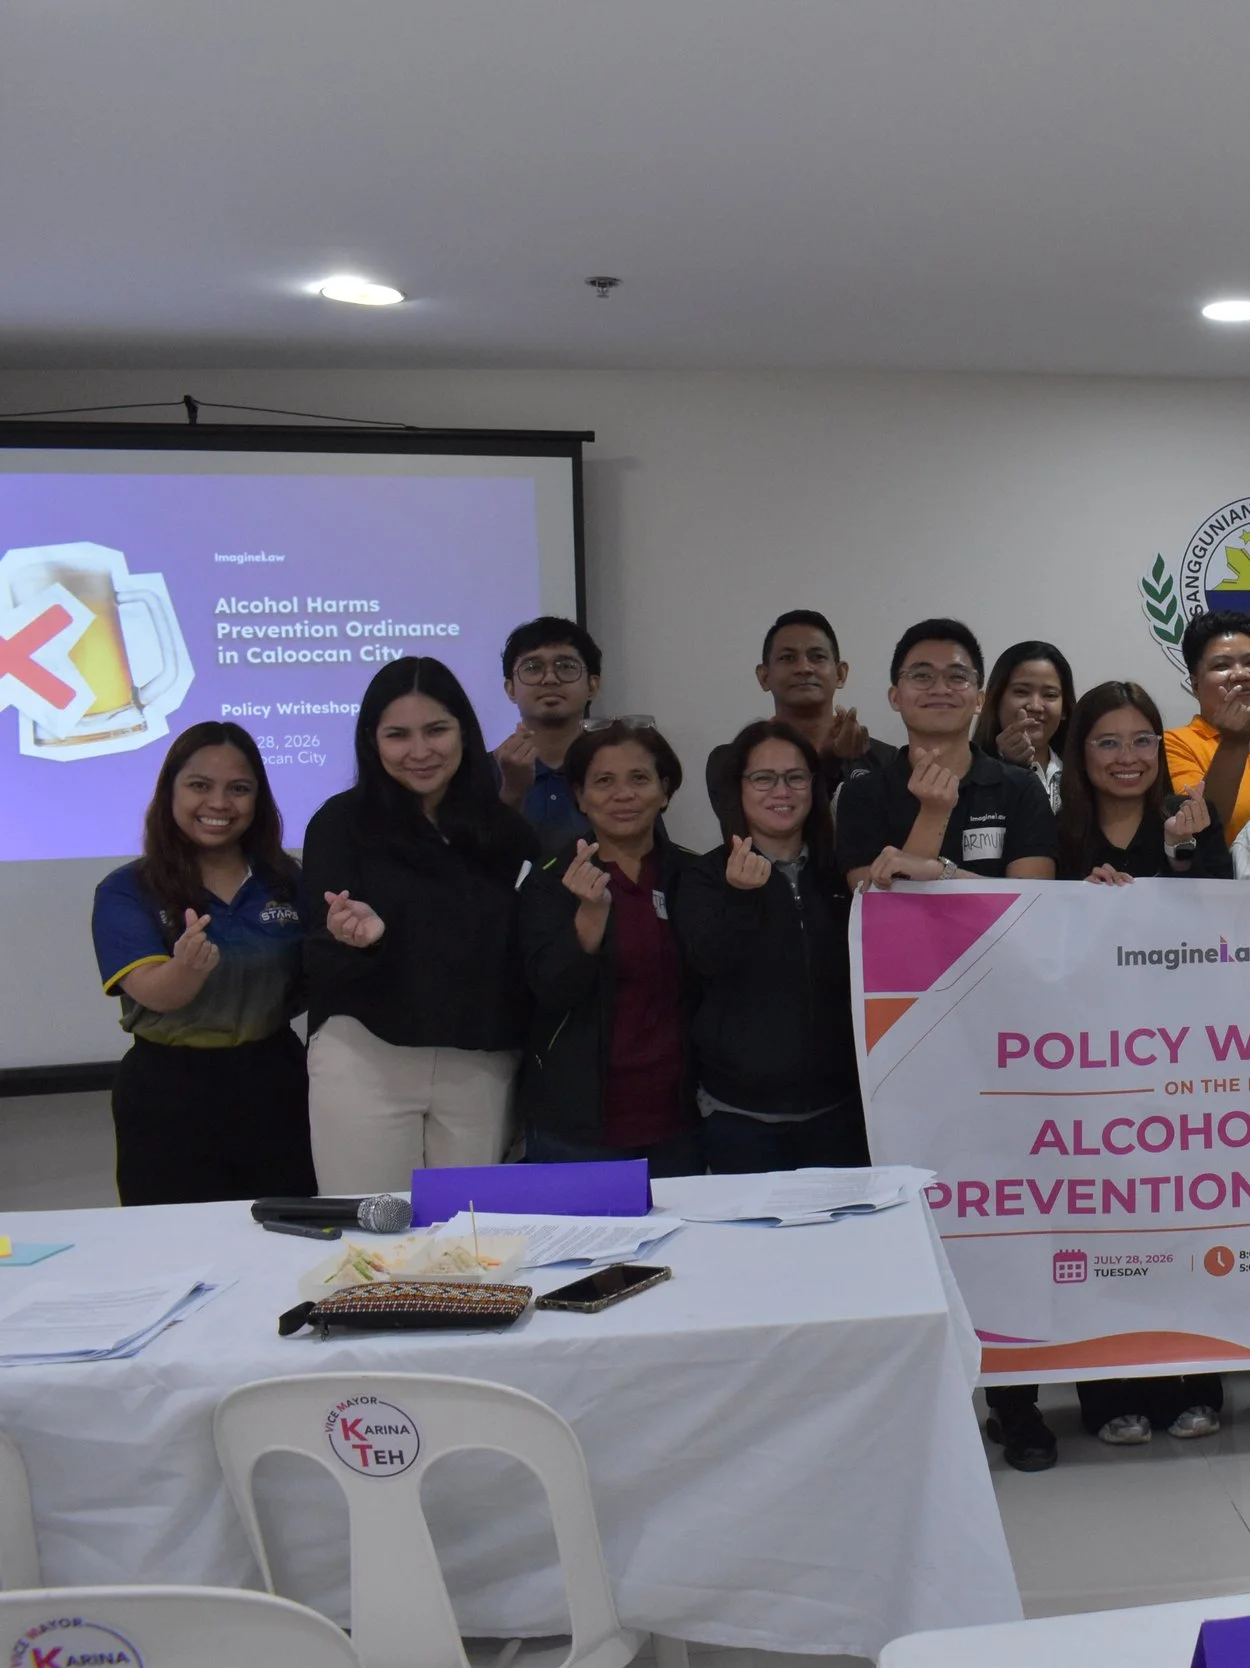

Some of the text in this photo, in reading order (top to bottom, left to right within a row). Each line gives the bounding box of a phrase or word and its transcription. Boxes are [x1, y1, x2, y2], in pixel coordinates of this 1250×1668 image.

[215, 597, 380, 614] Alcohol Harms
[217, 619, 460, 639] Prevention Ordinance
[218, 644, 404, 664] in Caloocan City
[221, 701, 361, 718] Policy Writeshop
[257, 735, 320, 750] 28, 2026
[298, 751, 327, 767] City
[261, 909, 299, 921] STARS
[997, 1026, 1191, 1070] POLICY
[1164, 1081, 1195, 1096] ON
[1200, 1078, 1241, 1094] THE
[1093, 1254, 1174, 1265] JULY 28, 2026
[1093, 1267, 1149, 1277] TUESDAY
[325, 1396, 378, 1433] VICE MAYOR
[340, 1417, 411, 1442] KARINA
[351, 1443, 405, 1467] TEH
[26, 1617, 83, 1640] MAYOR
[32, 1646, 130, 1668] KARINA
